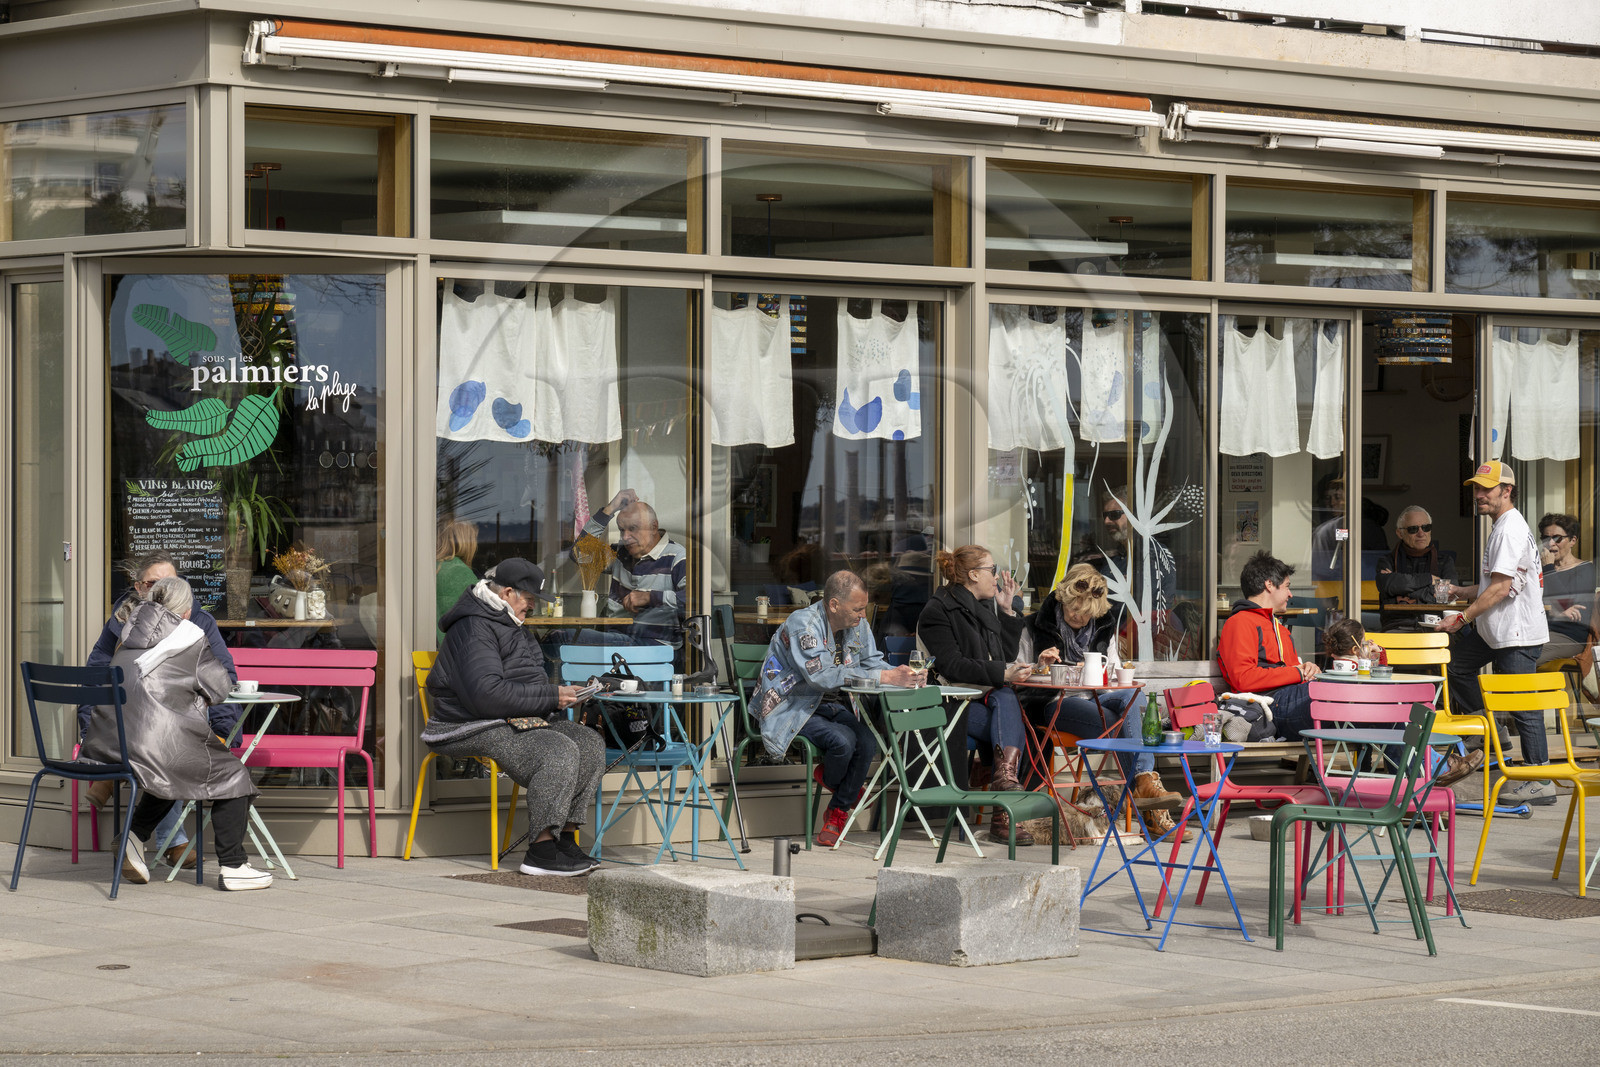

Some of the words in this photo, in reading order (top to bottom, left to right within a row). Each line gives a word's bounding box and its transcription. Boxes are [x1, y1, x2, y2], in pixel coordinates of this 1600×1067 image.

[202, 355, 225, 363] sous
[239, 352, 253, 363] les
[190, 356, 330, 391] palmiers
[305, 385, 320, 411] la
[320, 370, 357, 414] plage
[139, 480, 168, 490] VINS
[159, 490, 175, 498] bio
[180, 560, 211, 569] ROUGES
